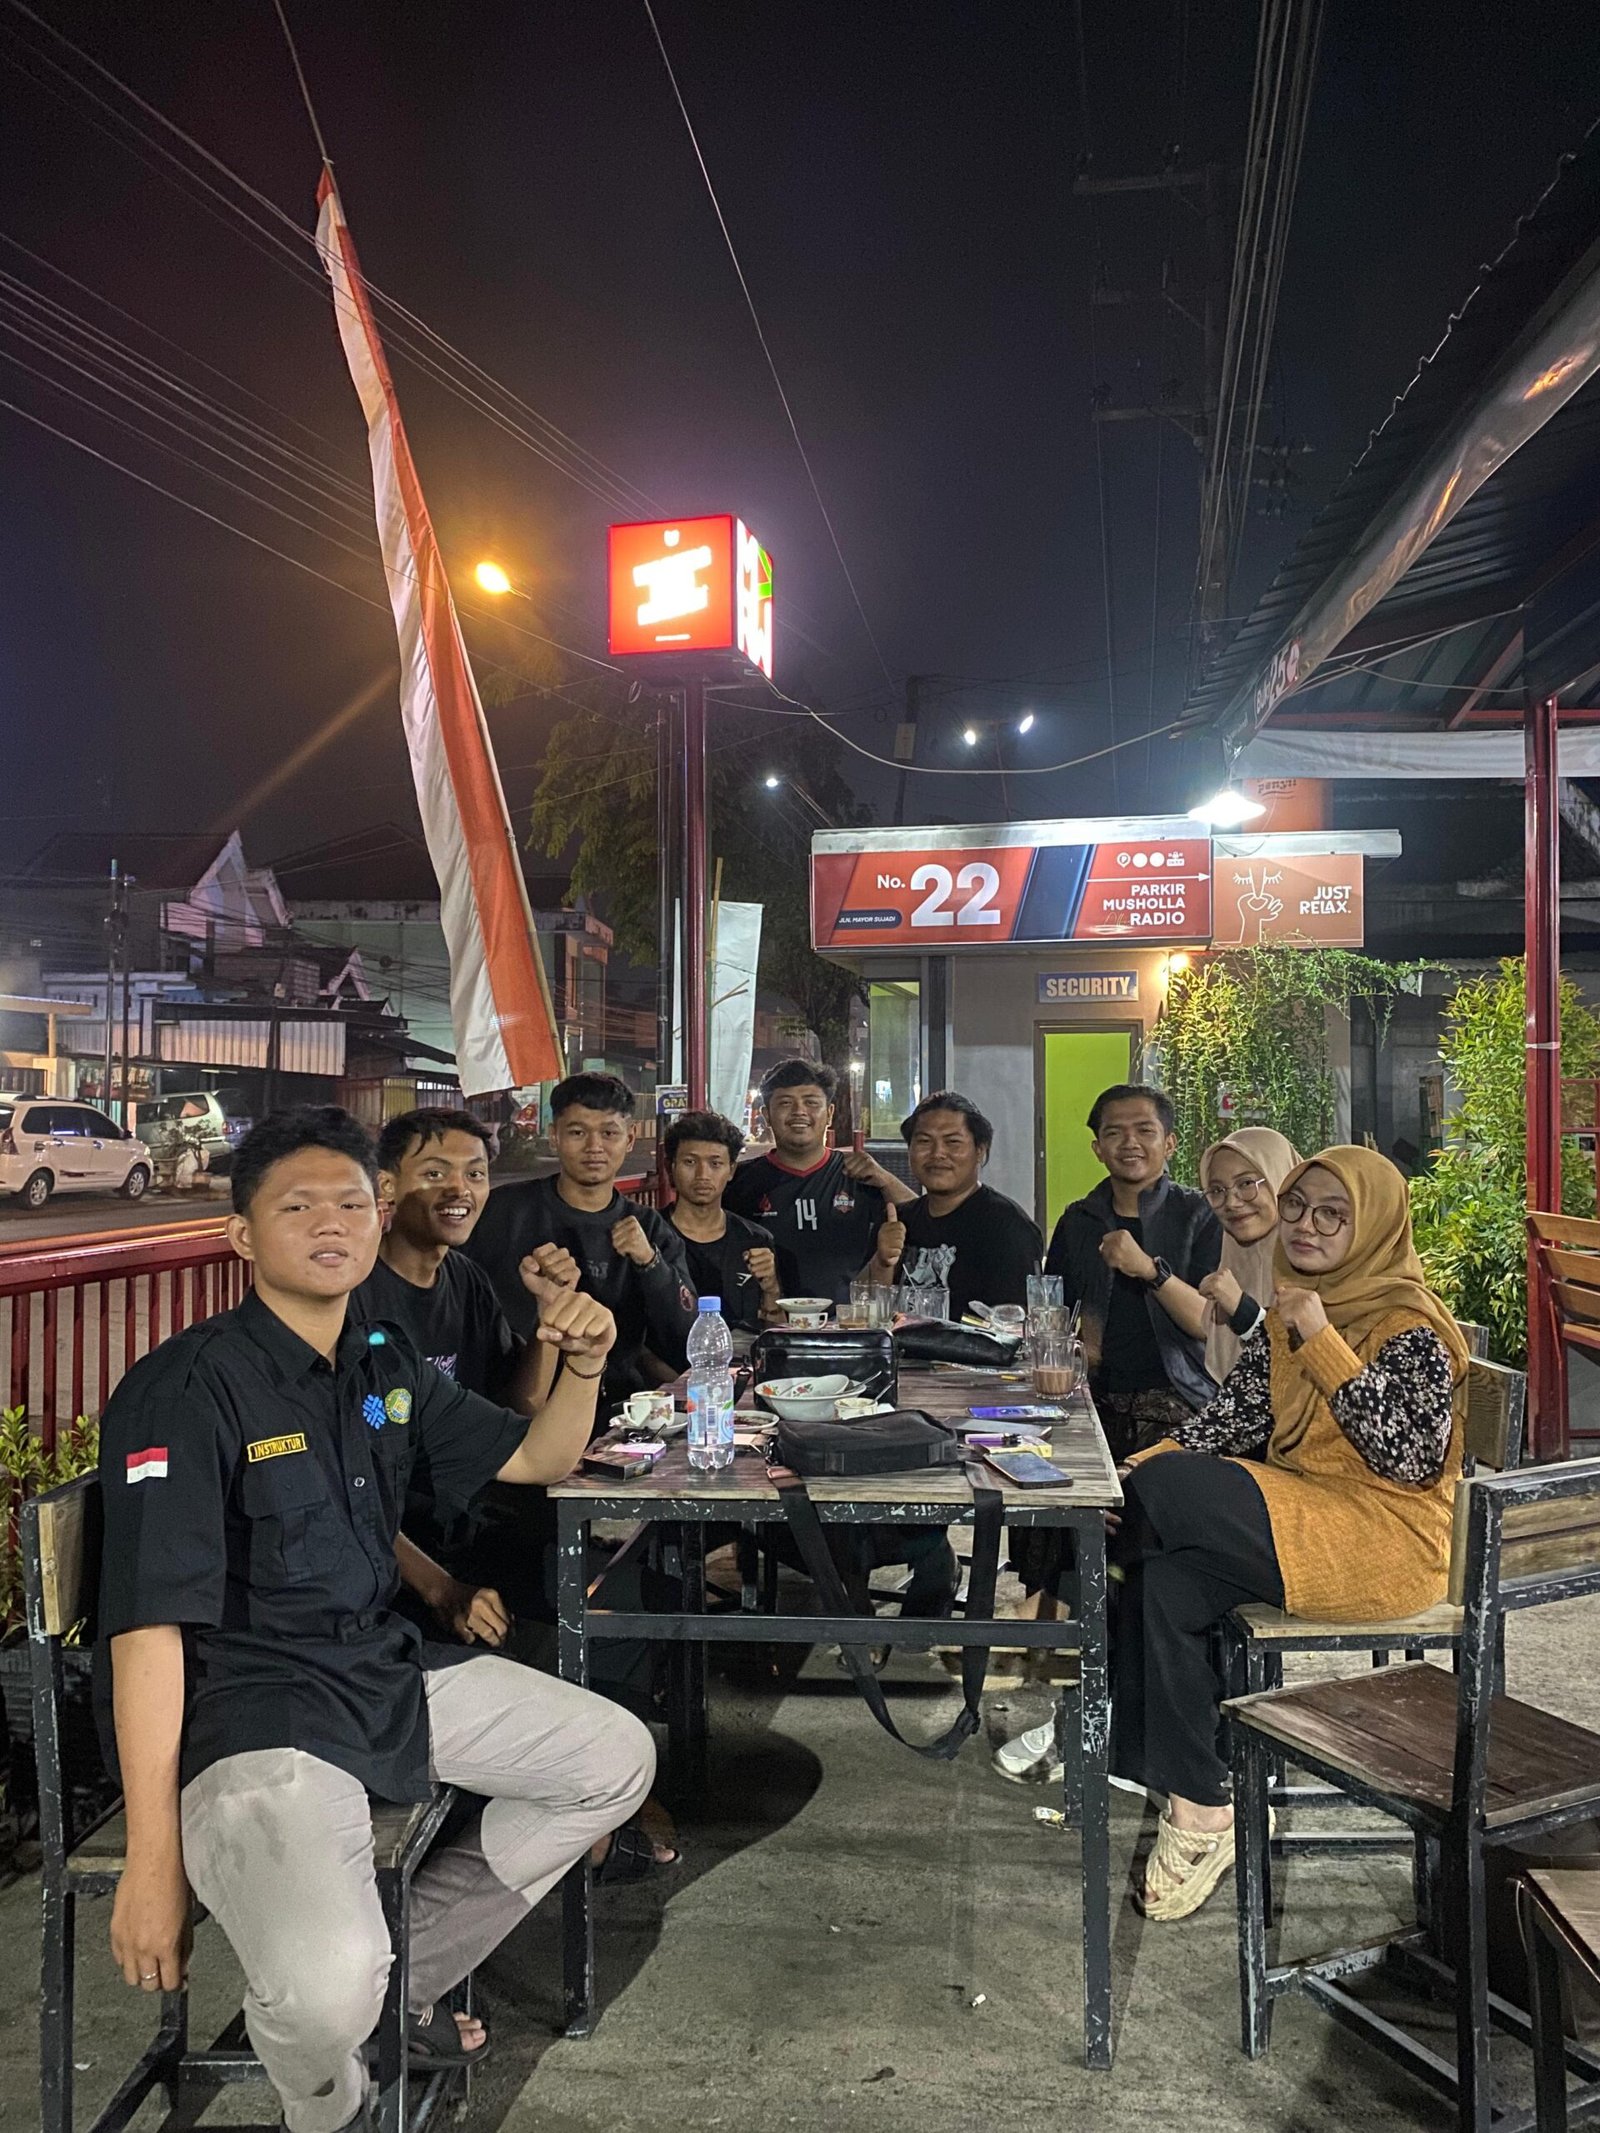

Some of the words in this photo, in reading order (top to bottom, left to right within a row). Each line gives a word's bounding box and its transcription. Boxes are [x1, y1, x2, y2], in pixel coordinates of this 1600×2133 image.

[877, 874, 906, 889] No.
[910, 862, 1001, 927] 22
[1131, 883, 1186, 896] PARKIR
[1313, 885, 1352, 900] JUST
[1103, 897, 1186, 911] MUSHOLLA
[1300, 900, 1352, 915] RELAX.
[1130, 911, 1185, 926] RADIO
[1046, 976, 1131, 997] SECURITY
[794, 1197, 818, 1231] 14
[253, 1437, 302, 1458] INSTRUKTUR
